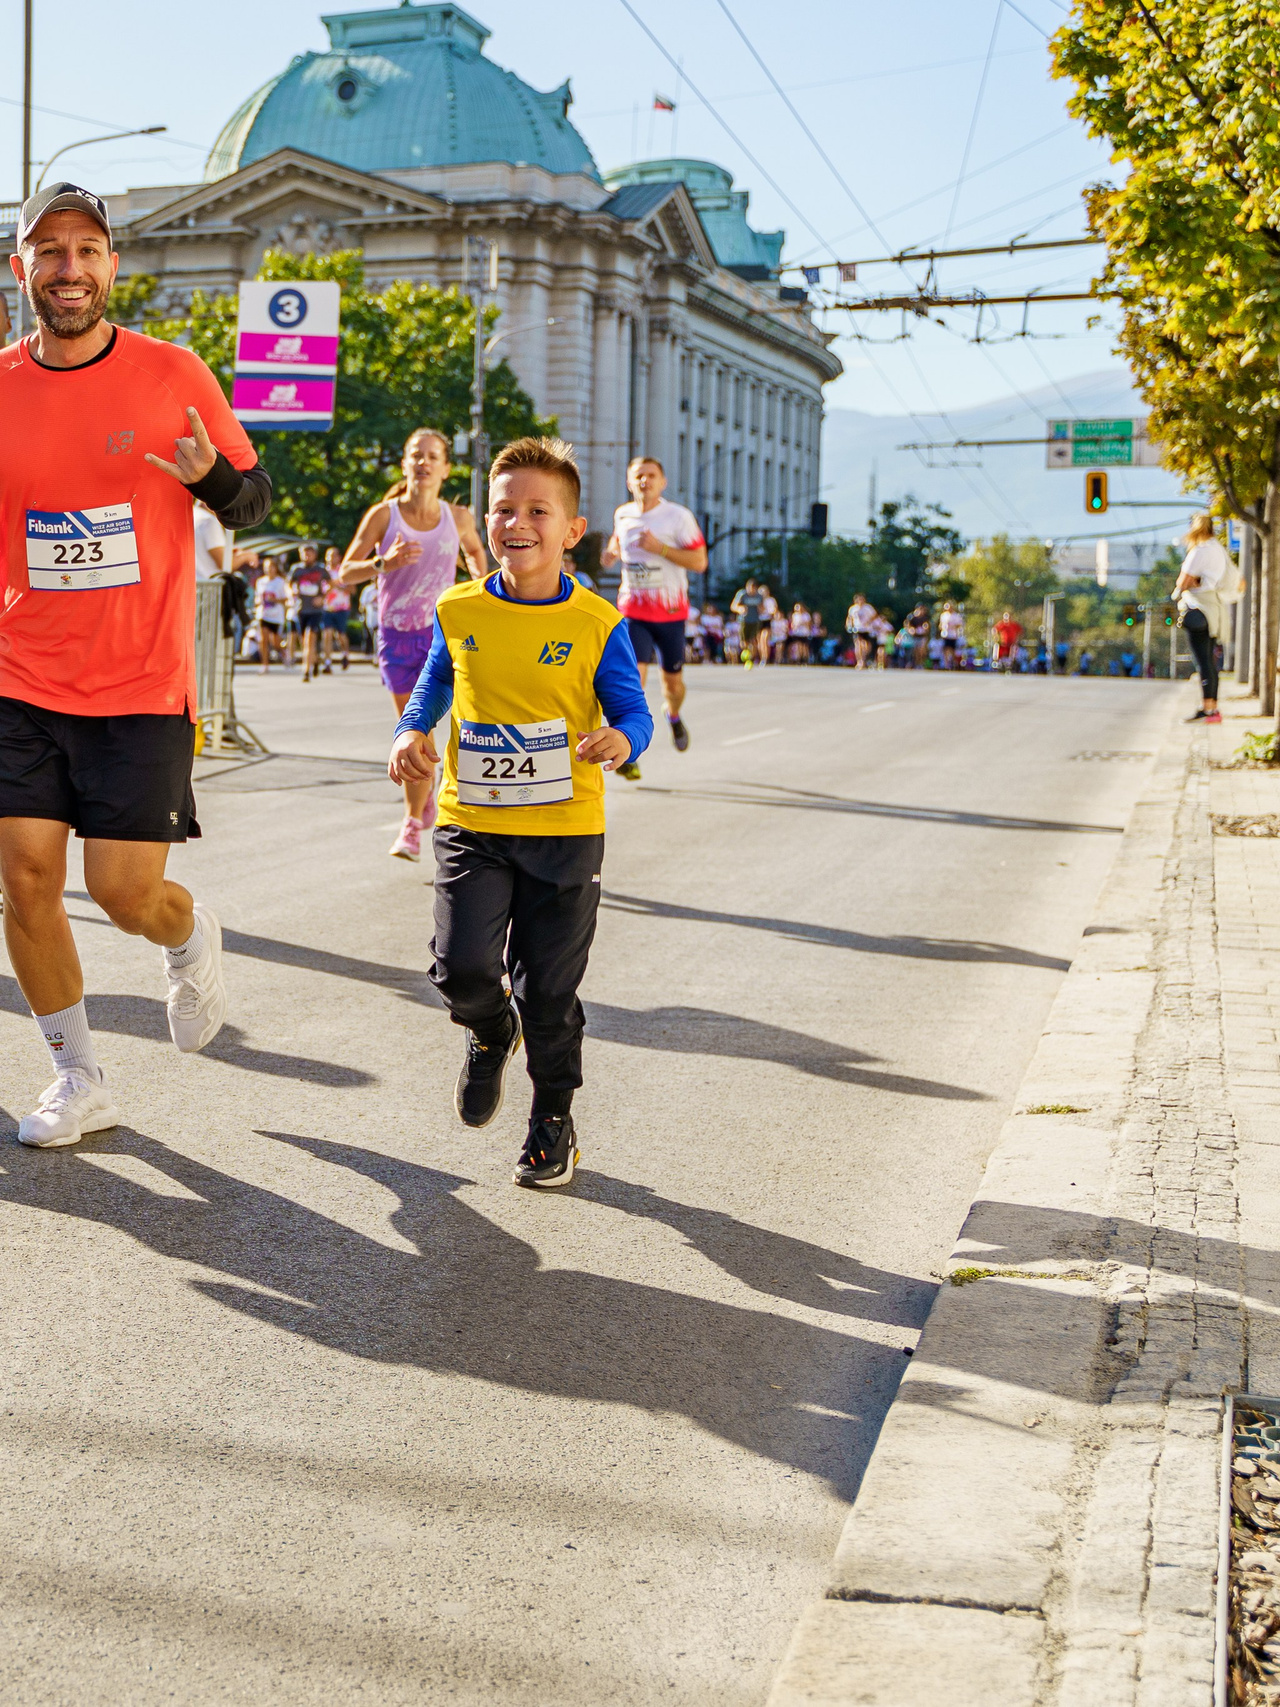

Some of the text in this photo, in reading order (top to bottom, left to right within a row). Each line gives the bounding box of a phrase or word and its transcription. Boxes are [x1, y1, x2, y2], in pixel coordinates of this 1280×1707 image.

[275, 294, 301, 323] 3
[28, 518, 74, 534] Fibank
[92, 527, 119, 535] MARATHON
[53, 541, 104, 564] 223
[460, 730, 504, 747] Fibank
[524, 743, 553, 751] MARATHON
[481, 757, 537, 778] 224
